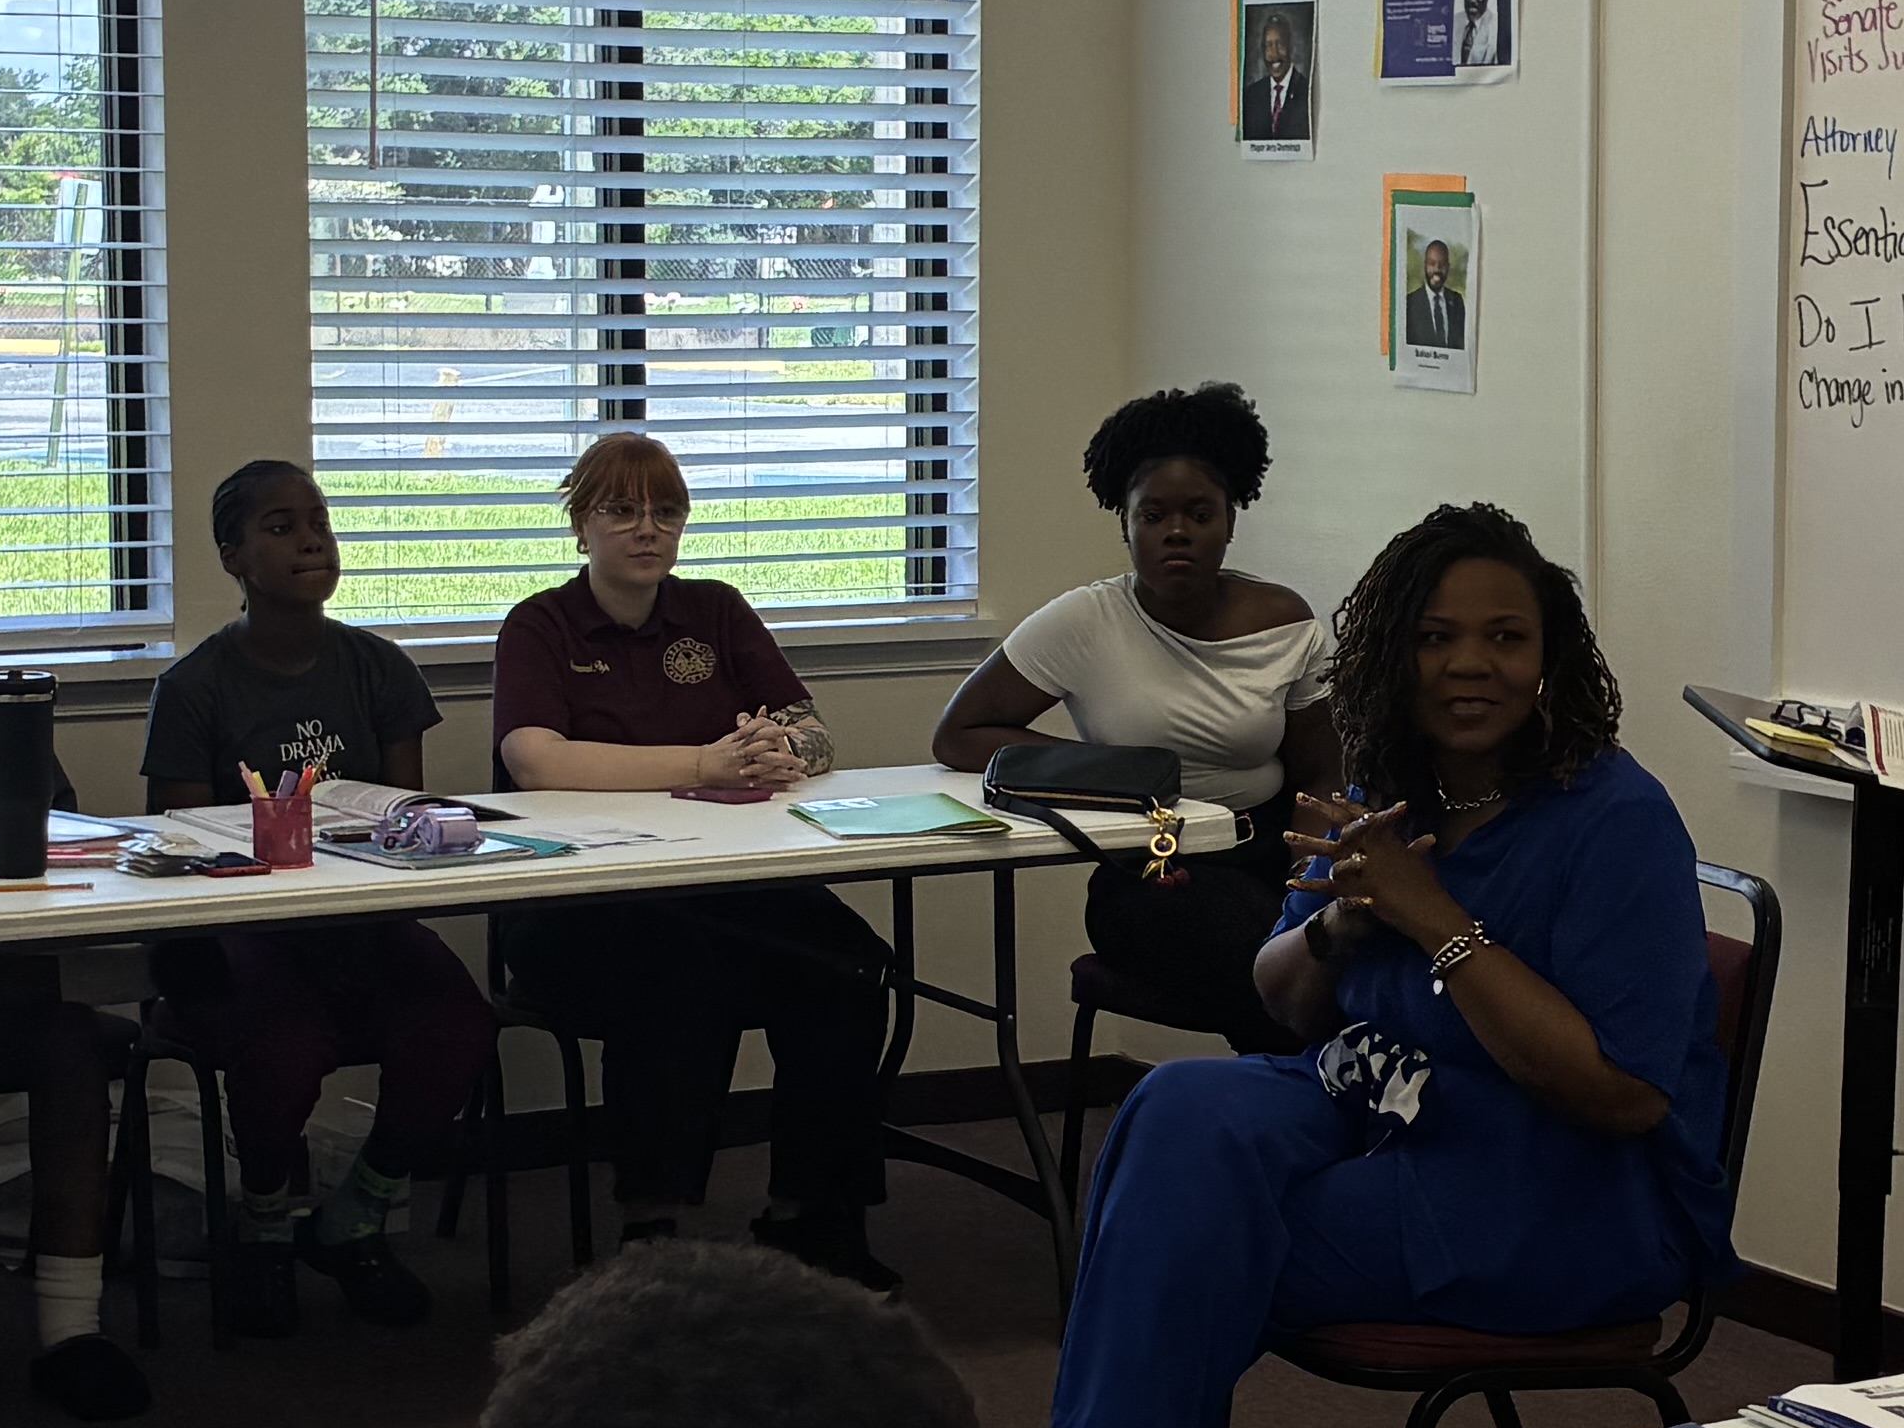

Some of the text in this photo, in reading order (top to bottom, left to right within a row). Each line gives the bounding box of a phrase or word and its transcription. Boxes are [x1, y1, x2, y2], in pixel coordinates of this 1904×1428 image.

[1807, 36, 1869, 83] Visits
[1800, 115, 1897, 180] Attorney
[1794, 294, 1836, 349] Do
[1849, 297, 1886, 351] I
[1881, 368, 1904, 402] in
[280, 734, 345, 762] DRAMA
[296, 719, 323, 740] NO
